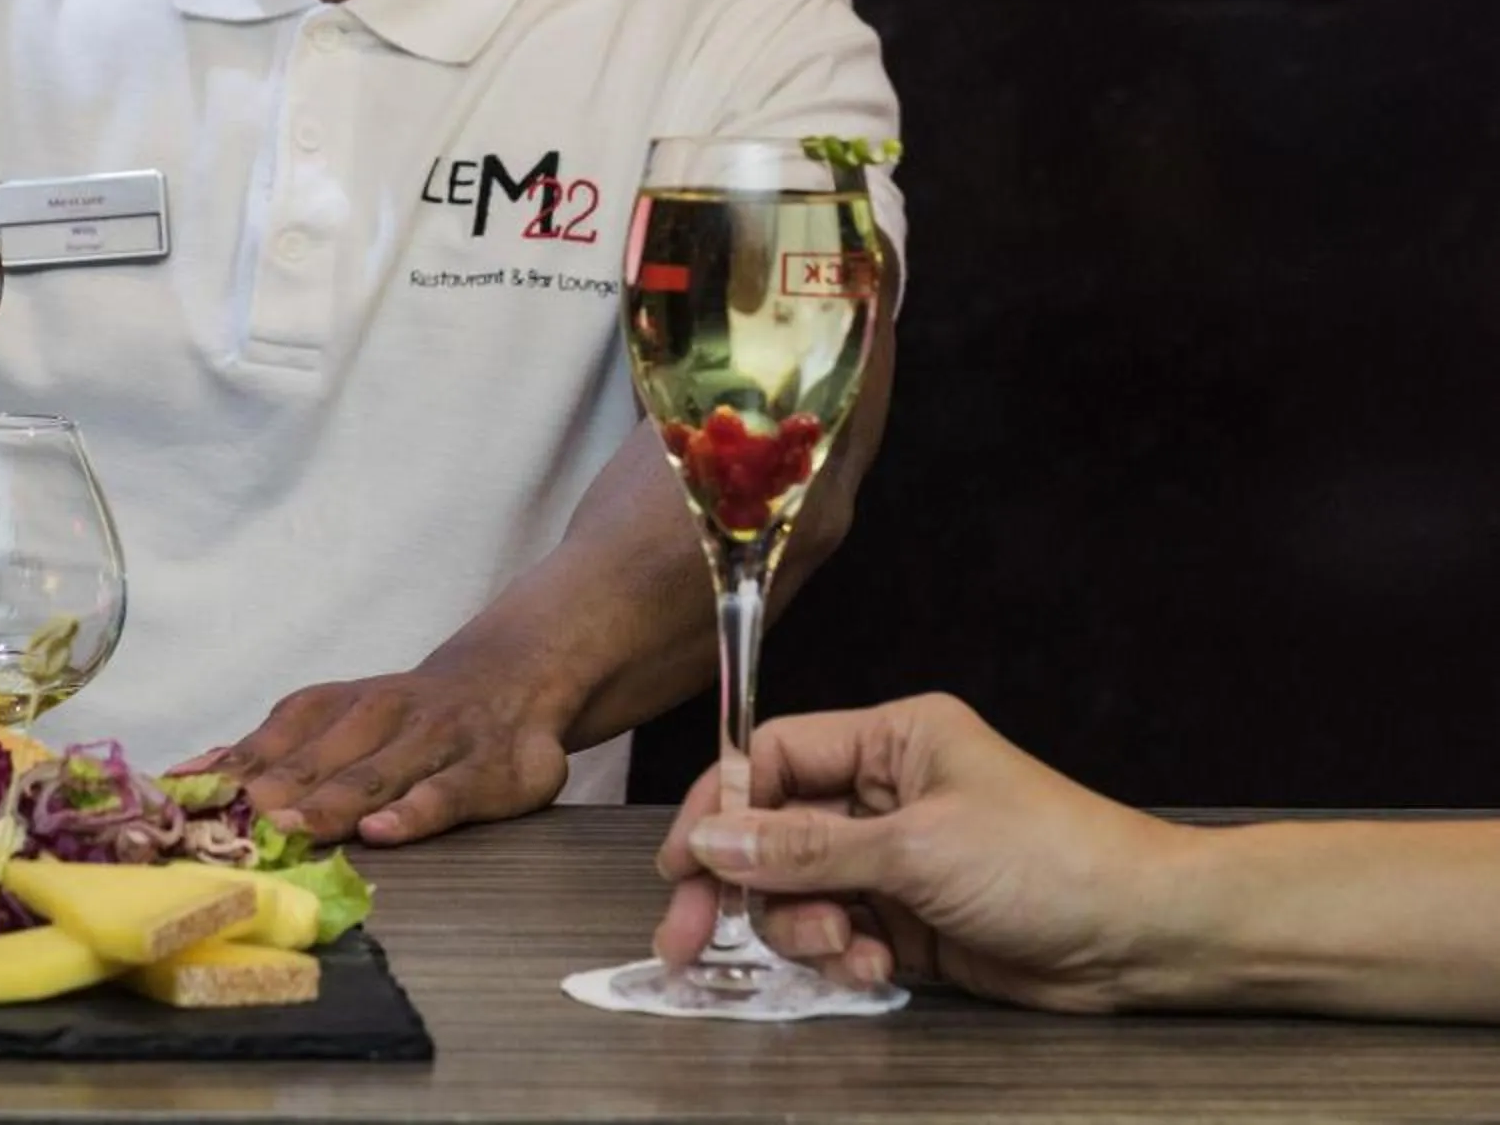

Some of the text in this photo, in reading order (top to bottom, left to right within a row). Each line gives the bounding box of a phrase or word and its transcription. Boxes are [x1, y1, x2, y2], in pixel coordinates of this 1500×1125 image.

[409, 269, 619, 298] Restaurant & Bar Lounge
